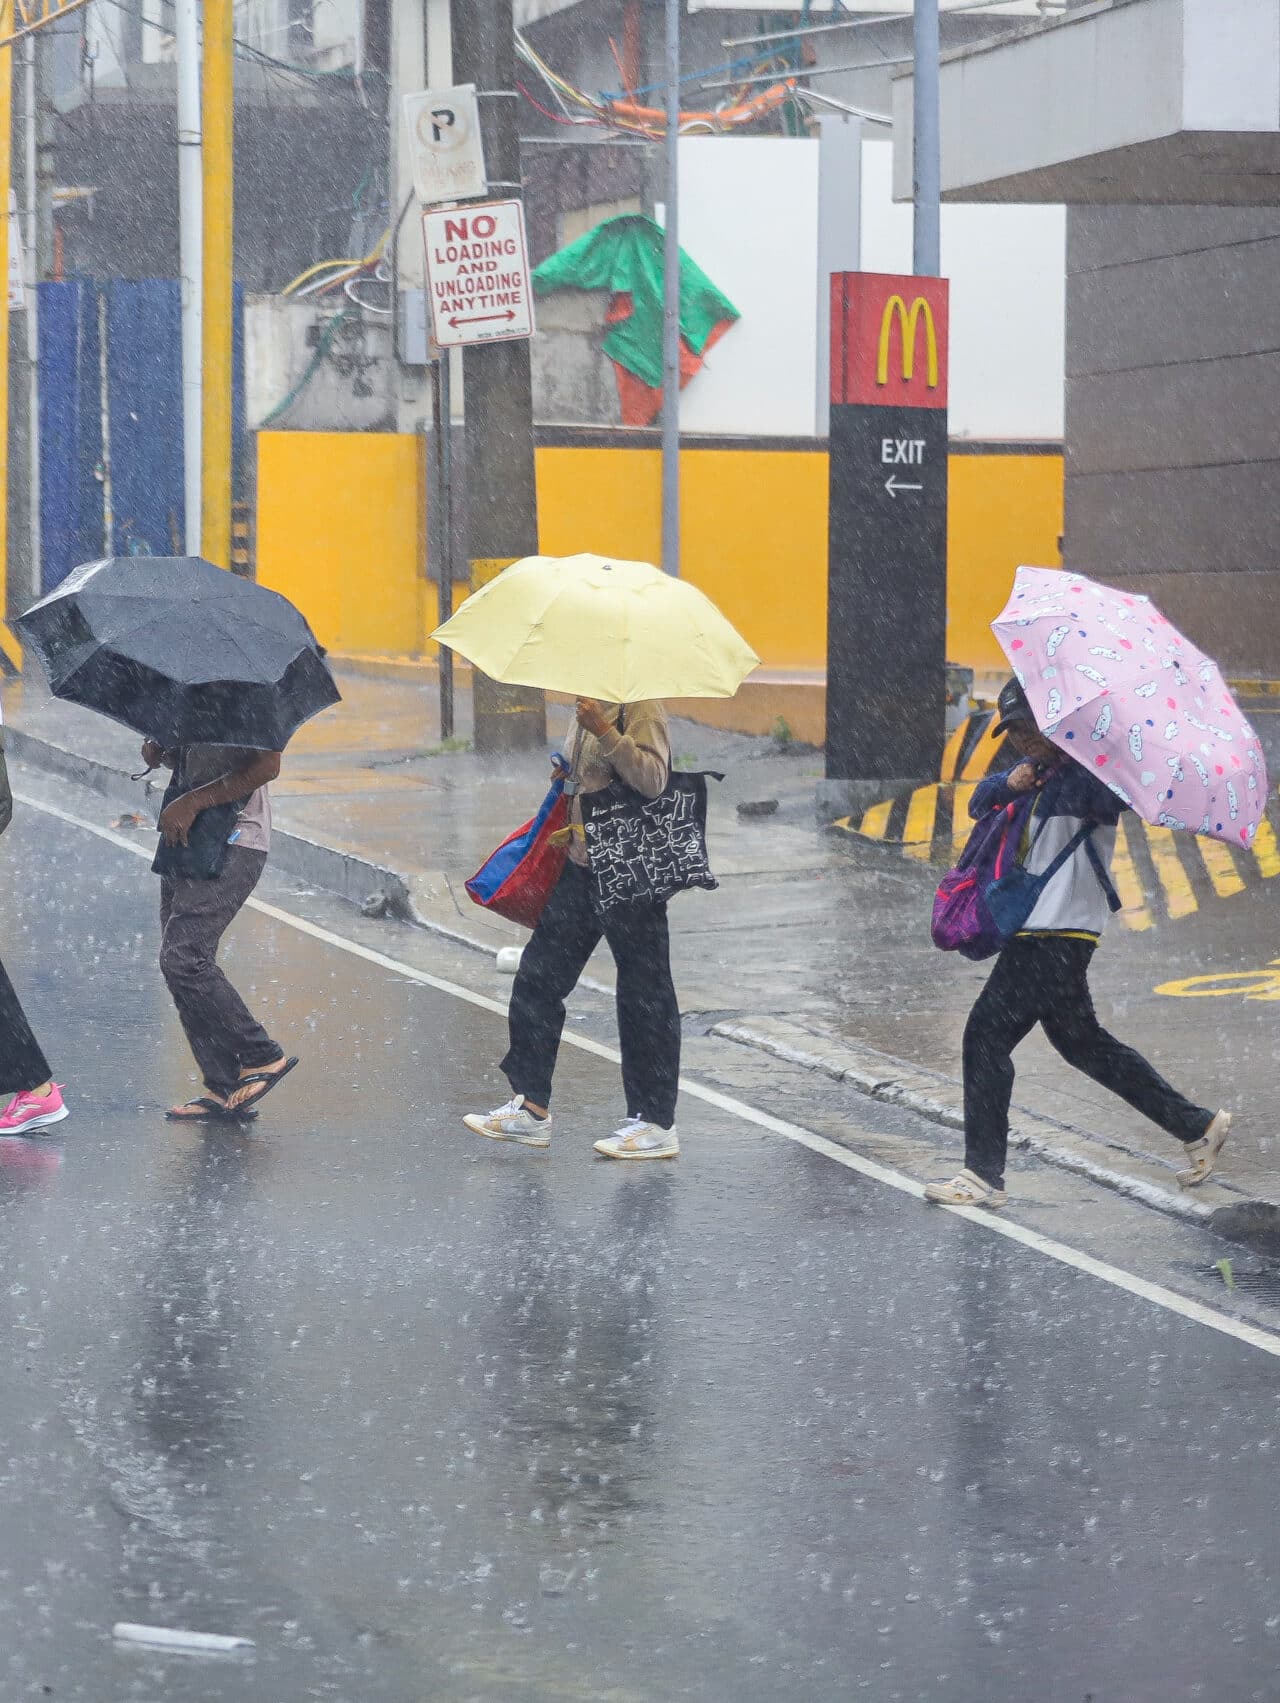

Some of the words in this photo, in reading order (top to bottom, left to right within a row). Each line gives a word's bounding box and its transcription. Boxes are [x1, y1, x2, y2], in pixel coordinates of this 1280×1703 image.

[430, 108, 456, 142] P
[444, 215, 497, 242] NO
[435, 239, 517, 265] LOADING
[457, 260, 498, 276] AND
[435, 271, 522, 298] UNLOADING
[439, 291, 522, 314] ANYTIME
[881, 438, 926, 465] EXIT
